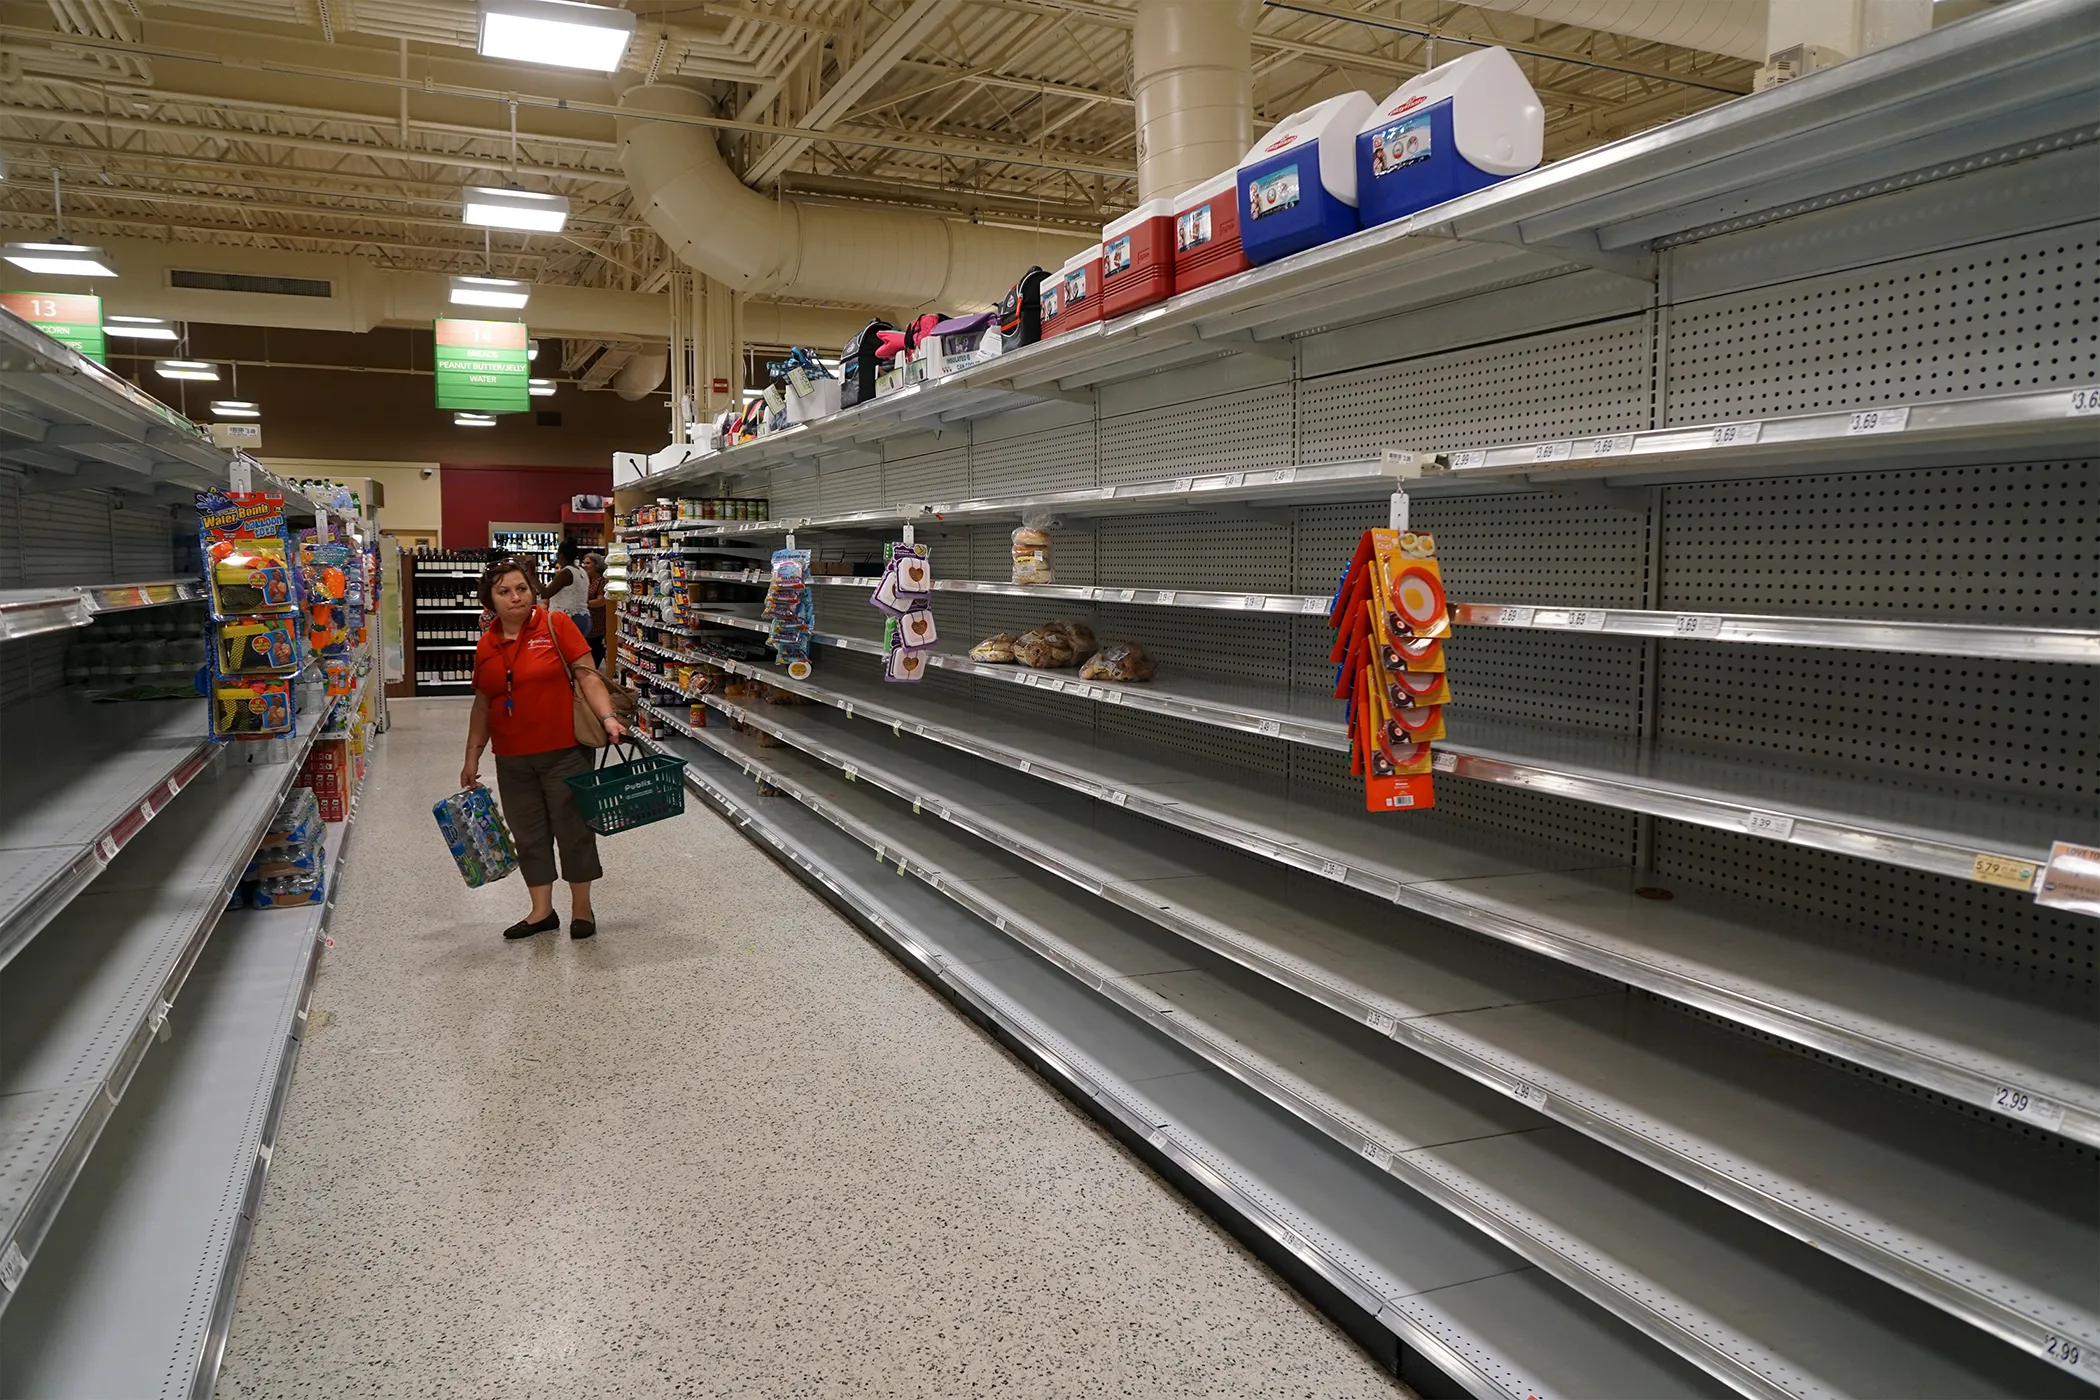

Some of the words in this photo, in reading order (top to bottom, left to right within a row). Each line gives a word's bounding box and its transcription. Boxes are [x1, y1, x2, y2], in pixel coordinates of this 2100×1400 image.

[31, 299, 57, 317] 13
[36, 325, 71, 335] CORN
[473, 327, 492, 343] 14
[439, 361, 471, 371] PEANUT
[472, 362, 527, 373] BUTTER/JELLY
[469, 375, 497, 384] WATER
[2072, 390, 2100, 410] $3.6
[203, 513, 238, 529] Water
[238, 503, 270, 519] Bomb
[624, 780, 654, 792] Publix
[1996, 1086, 2029, 1112] $2.99
[2044, 1333, 2079, 1365] $2.99
